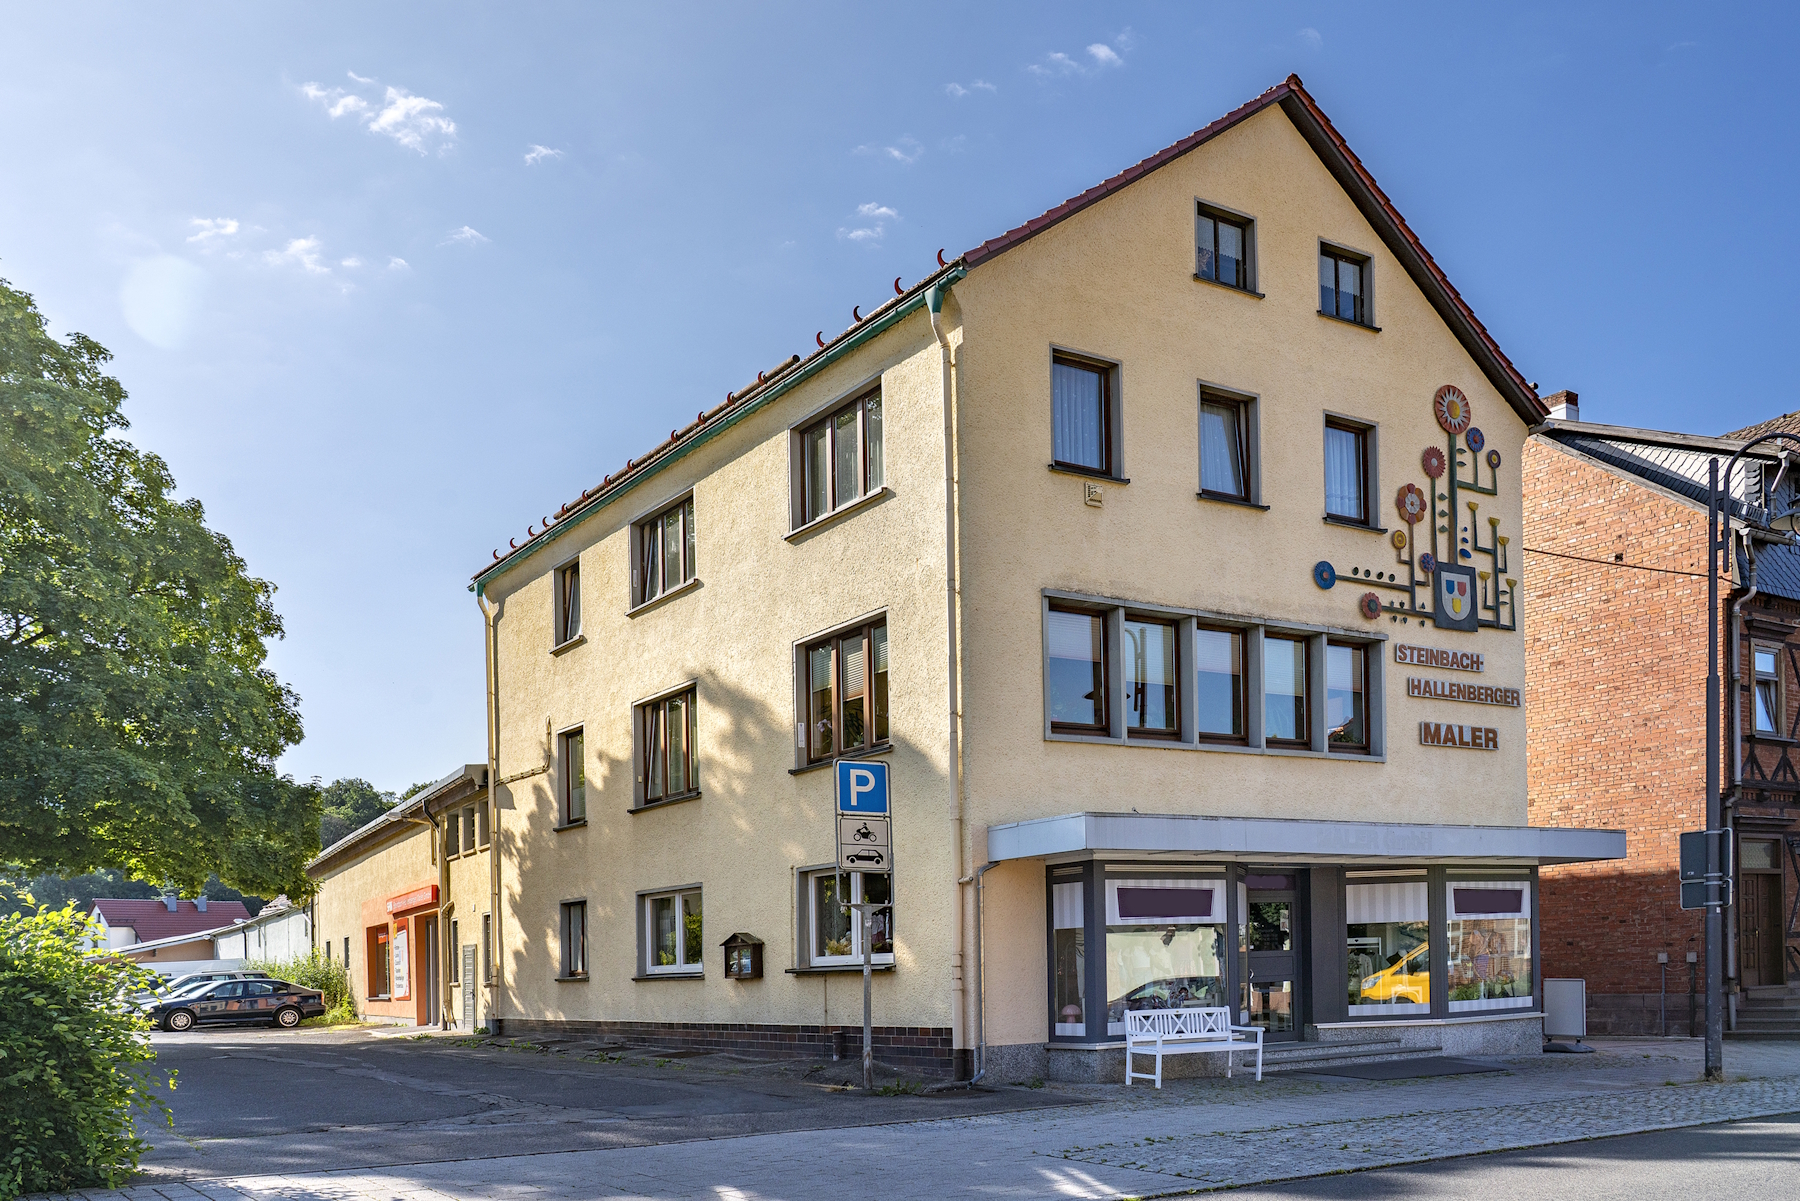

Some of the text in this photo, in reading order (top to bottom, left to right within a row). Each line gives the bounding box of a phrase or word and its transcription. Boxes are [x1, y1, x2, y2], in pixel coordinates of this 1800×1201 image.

[1410, 678, 1520, 706] HALLENBERGER
[1423, 722, 1499, 749] MALER
[849, 768, 876, 806] P
